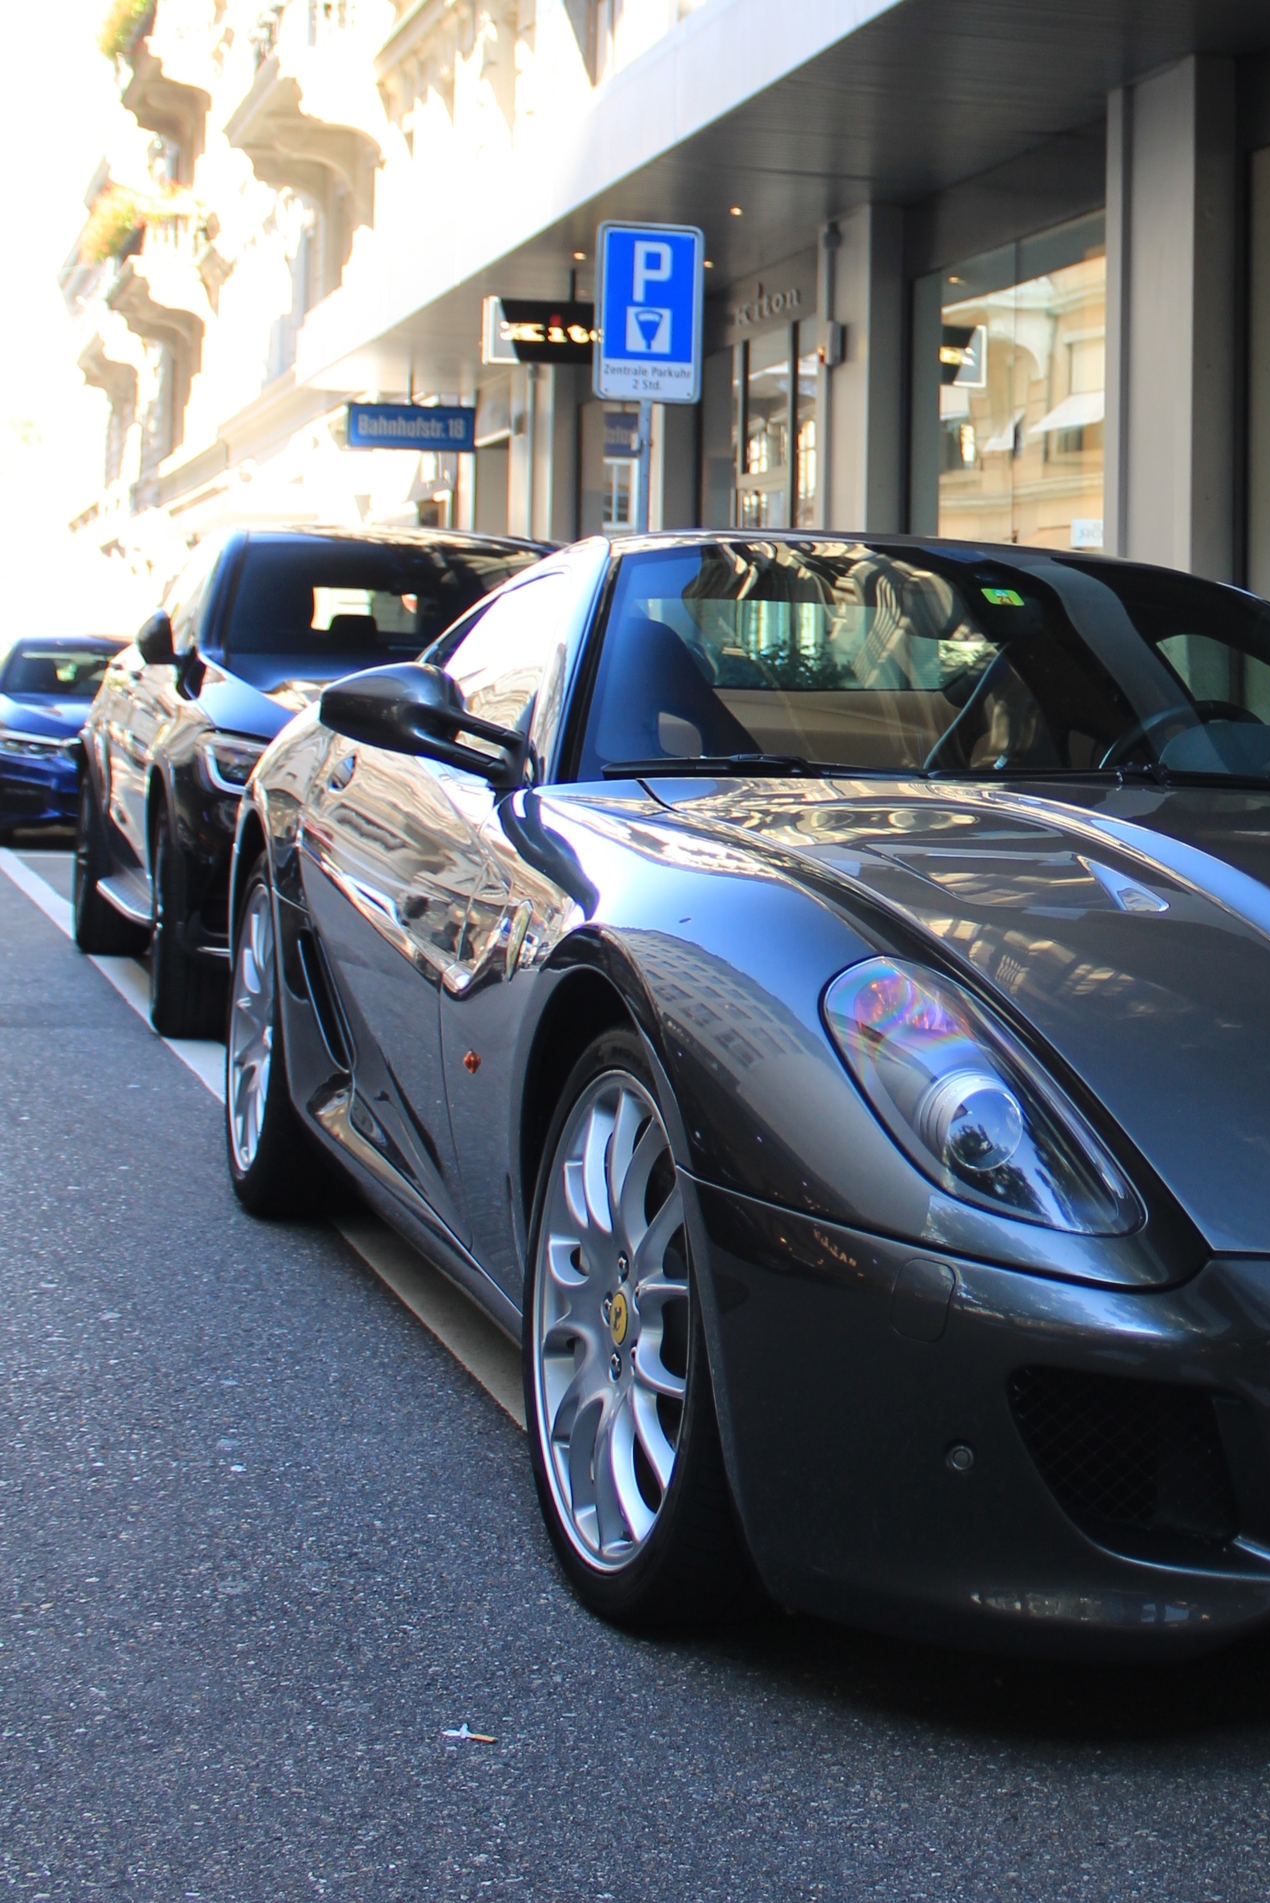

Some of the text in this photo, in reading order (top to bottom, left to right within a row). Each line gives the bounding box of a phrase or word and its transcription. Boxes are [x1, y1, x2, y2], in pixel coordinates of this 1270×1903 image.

[633, 240, 673, 303] P
[604, 364, 692, 379] Zentrale Parkuhr
[632, 379, 662, 391] 2 Std.
[357, 413, 444, 439] Bahnhofstr.
